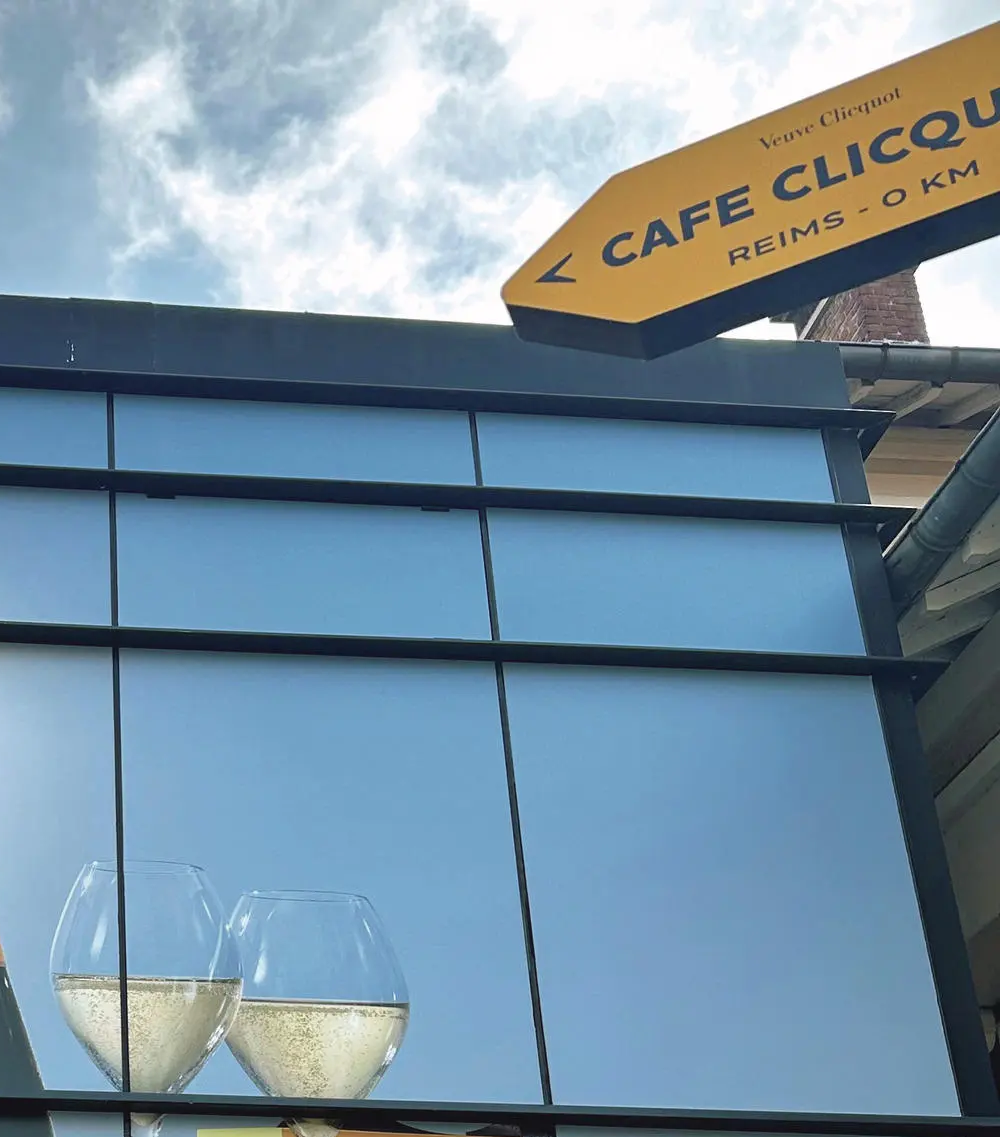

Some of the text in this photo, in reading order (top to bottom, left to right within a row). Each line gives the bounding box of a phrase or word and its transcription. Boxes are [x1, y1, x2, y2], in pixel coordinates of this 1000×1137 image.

[759, 87, 903, 151] Veuve Clicquot
[602, 87, 1000, 267] CAFE CLICQU
[728, 211, 845, 266] REIMS
[922, 160, 980, 195] KM
